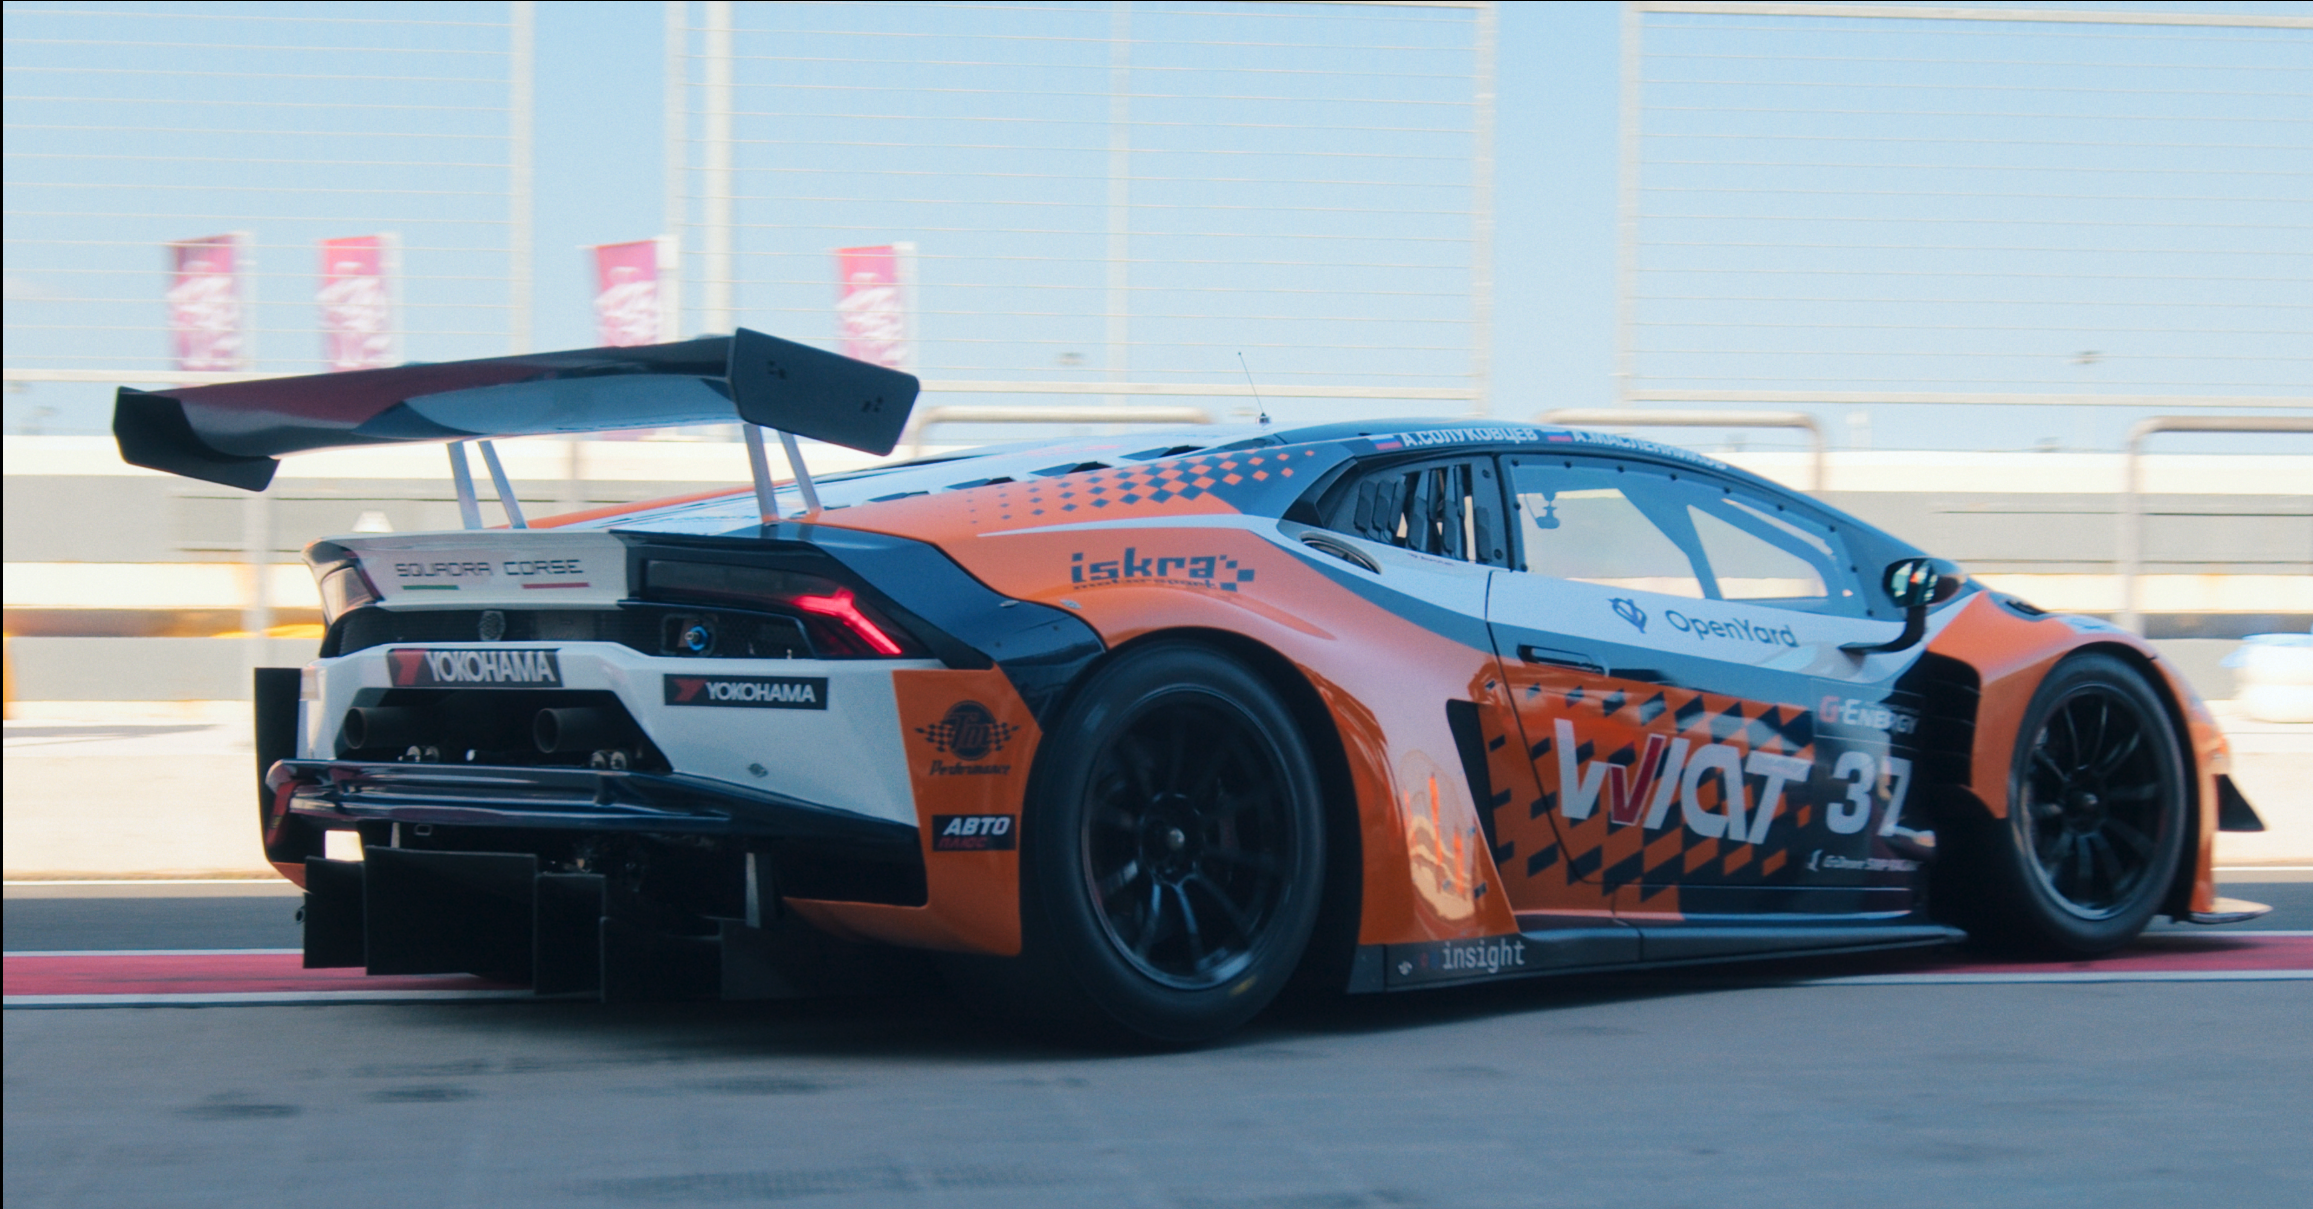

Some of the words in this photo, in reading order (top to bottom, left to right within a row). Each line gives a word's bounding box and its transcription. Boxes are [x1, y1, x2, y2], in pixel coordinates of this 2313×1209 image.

[394, 561, 494, 578] SQUADRA
[503, 558, 584, 576] CORSE
[1071, 546, 1217, 584] iskra
[1664, 609, 1801, 648] OpenYard
[424, 650, 557, 683] YOKOHAMA
[705, 681, 817, 703] YOKOHAMA
[1825, 750, 1913, 838] 37
[1442, 937, 1526, 974] insight
